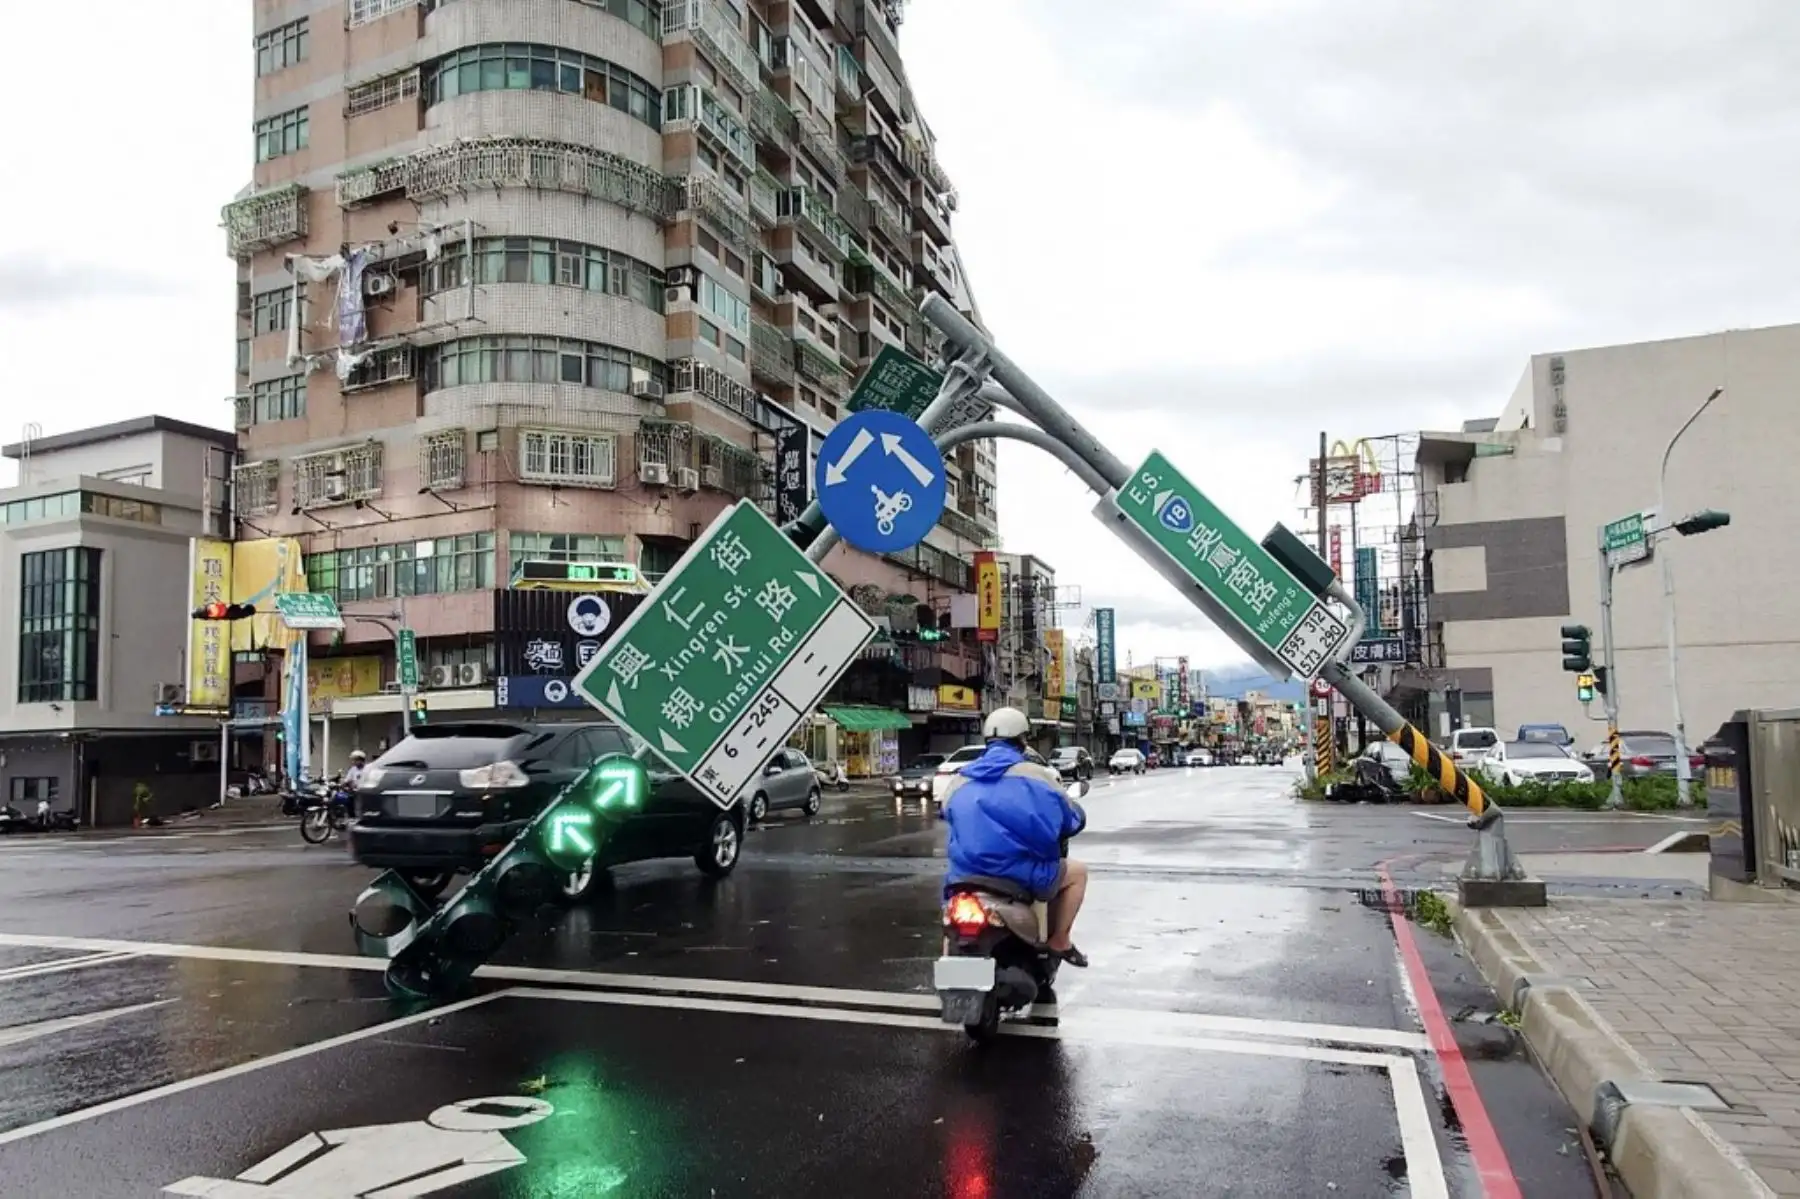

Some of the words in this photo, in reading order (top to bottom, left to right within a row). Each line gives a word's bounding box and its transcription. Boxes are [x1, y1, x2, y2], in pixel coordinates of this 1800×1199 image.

[1166, 504, 1187, 526] 18
[1186, 522, 1279, 616] 吳鳳南路
[659, 608, 728, 682] Xingren
[723, 583, 752, 610] St.
[1256, 595, 1292, 633] Wufeng
[1284, 634, 1305, 658] 595
[1304, 610, 1326, 633] 312
[661, 578, 798, 731] 親水路
[1300, 649, 1322, 672] 573
[1320, 625, 1341, 648] 290
[1353, 645, 1401, 660] 皮膚科
[708, 649, 773, 723] Qinshui
[768, 627, 799, 656] Rd.
